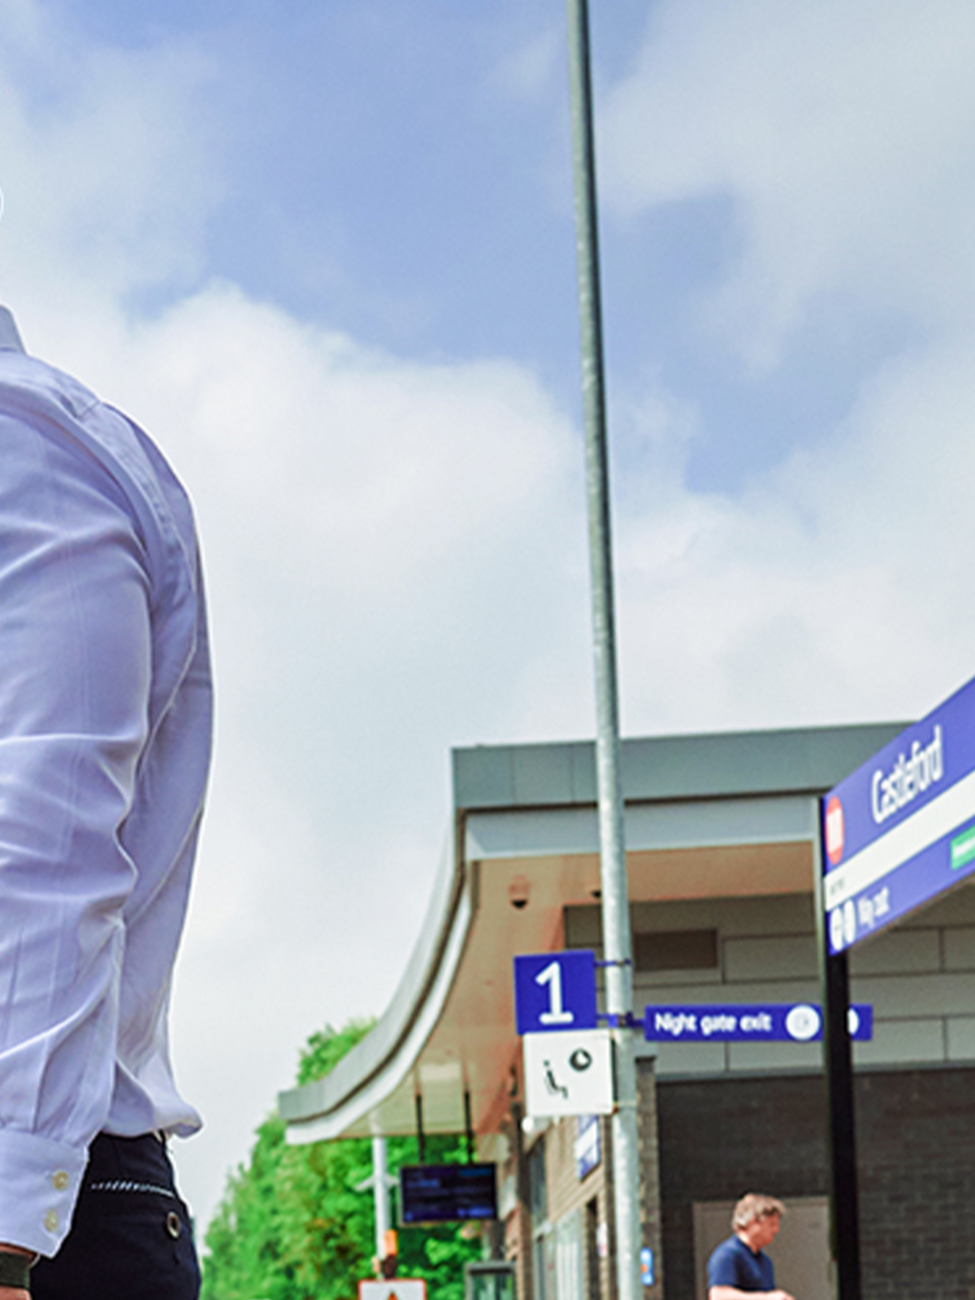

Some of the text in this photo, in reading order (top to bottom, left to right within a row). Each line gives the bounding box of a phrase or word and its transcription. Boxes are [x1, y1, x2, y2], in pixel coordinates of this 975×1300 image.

[872, 724, 943, 824] Castleford
[535, 961, 574, 1025] 1
[655, 1012, 772, 1036] Night gate exit
